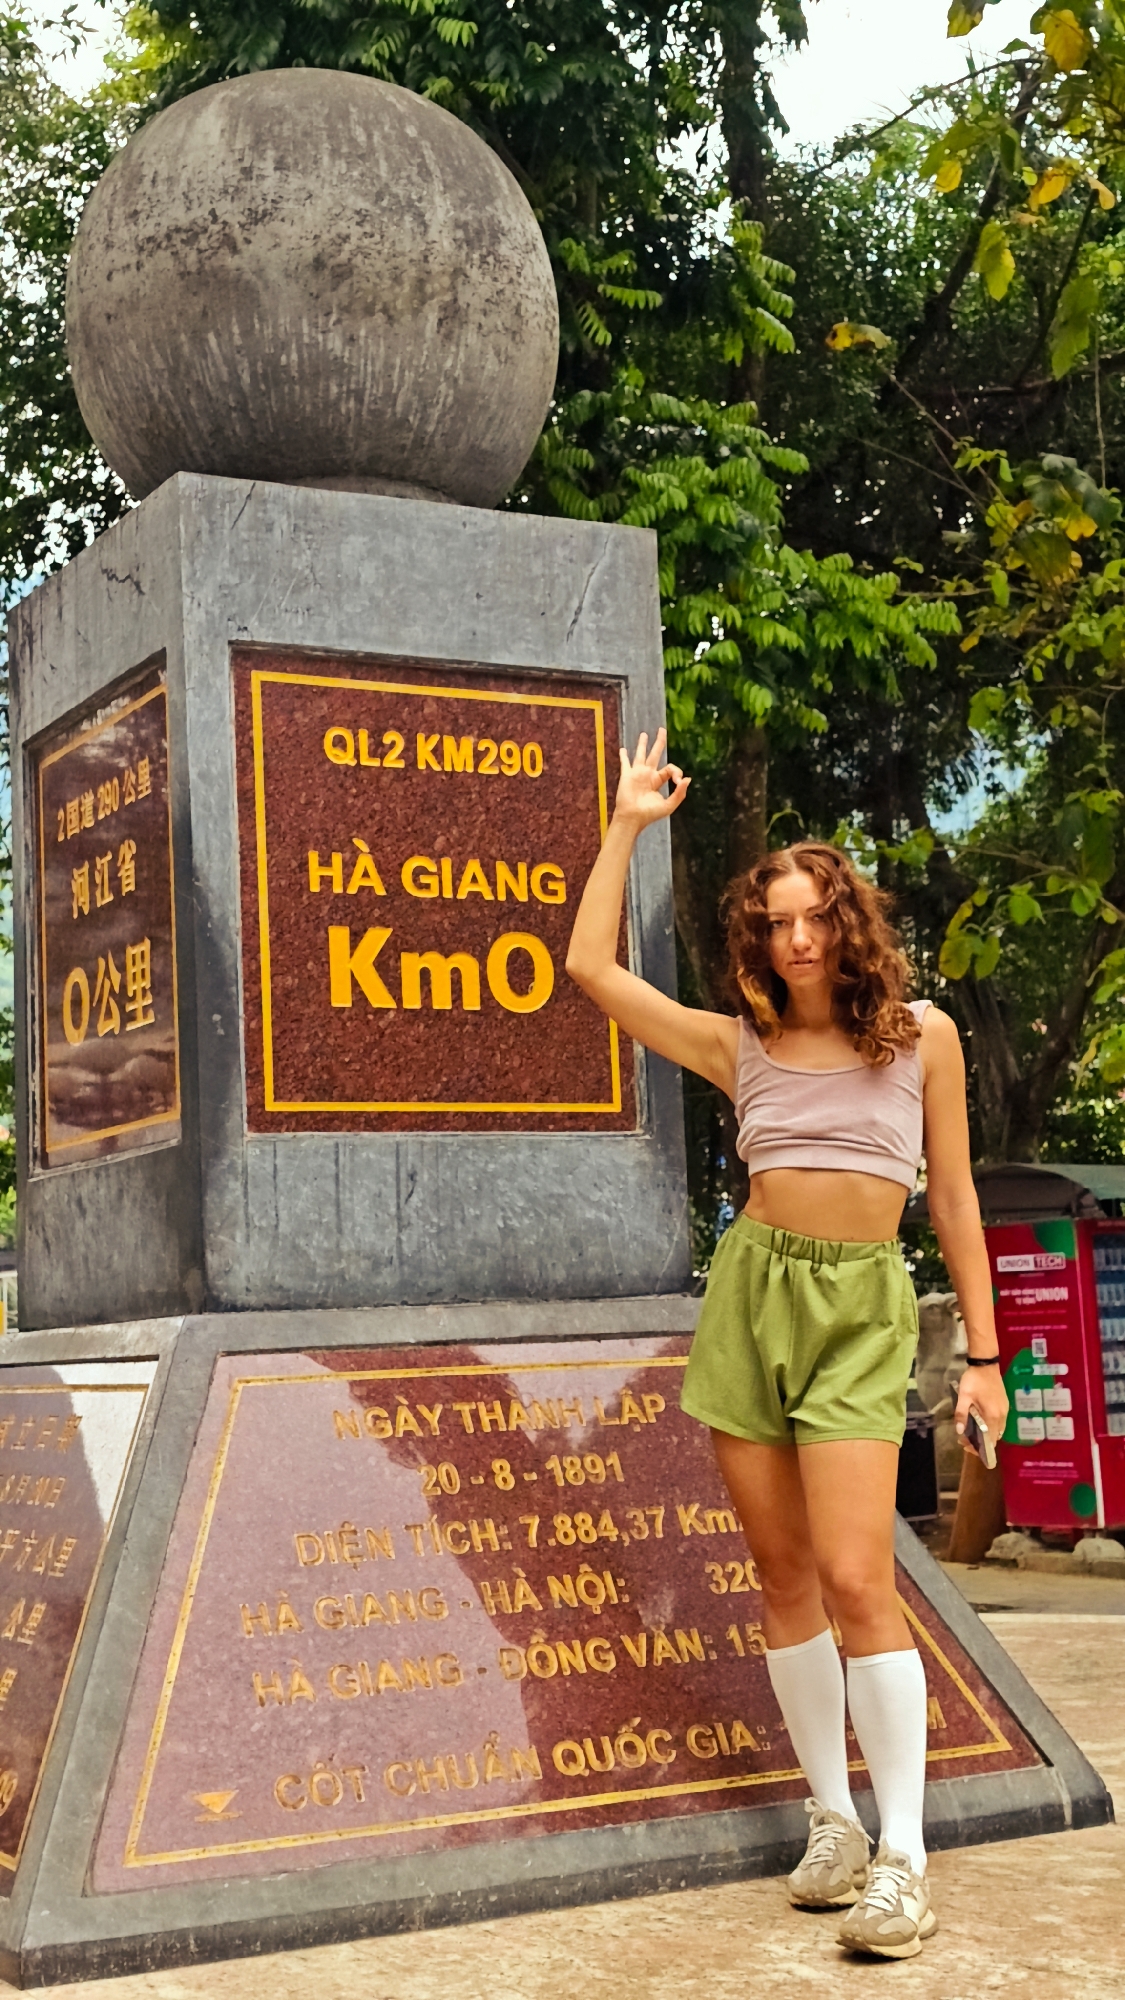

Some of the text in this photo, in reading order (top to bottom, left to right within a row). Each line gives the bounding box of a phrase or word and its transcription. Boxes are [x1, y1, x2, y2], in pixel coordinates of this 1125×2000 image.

[324, 727, 544, 778] QL2 KM290
[71, 839, 137, 919] 河江省
[308, 838, 567, 904] HÀ GIANG
[63, 937, 156, 1046] 0公里
[1035, 1287, 1068, 1301] UNION
[332, 1386, 666, 1439] NGÀY THÀNH LẬP
[416, 1462, 461, 1496] 20
[491, 1459, 516, 1491] 8
[545, 1451, 625, 1487] 1891
[295, 1502, 744, 1570] DIỆN TÍCH: 7.884,37 Km
[239, 1590, 304, 1638] HÀ
[314, 1587, 449, 1630] GIANG
[481, 1567, 543, 1616] HÀ
[547, 1563, 630, 1615] NỘI:
[252, 1658, 318, 1708] HÀ
[328, 1652, 464, 1700] GIANG
[498, 1628, 617, 1680] ĐỒNG
[620, 1624, 718, 1668] VĂN:
[384, 1730, 543, 1797] CHUẨN
[552, 1716, 677, 1777] QUỐC
[686, 1719, 770, 1759] GIA:
